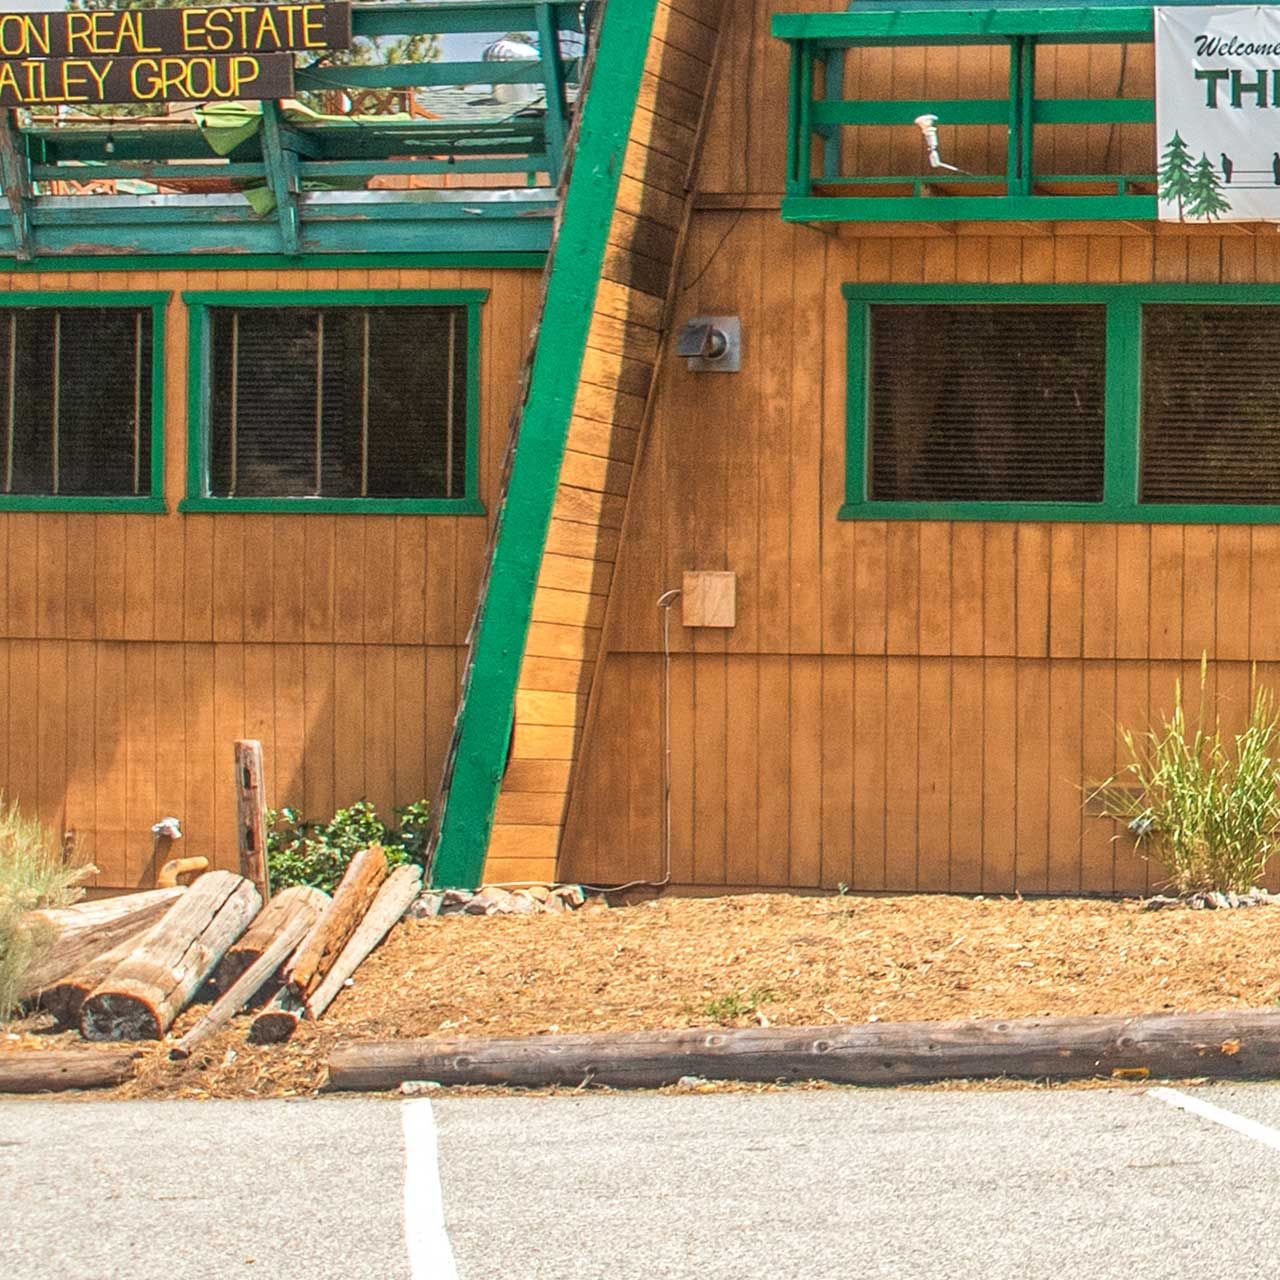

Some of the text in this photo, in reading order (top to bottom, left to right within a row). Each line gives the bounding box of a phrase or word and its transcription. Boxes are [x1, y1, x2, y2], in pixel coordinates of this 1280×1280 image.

[0, 4, 328, 56] ON REAL ESTATE
[130, 56, 260, 100] GROUP
